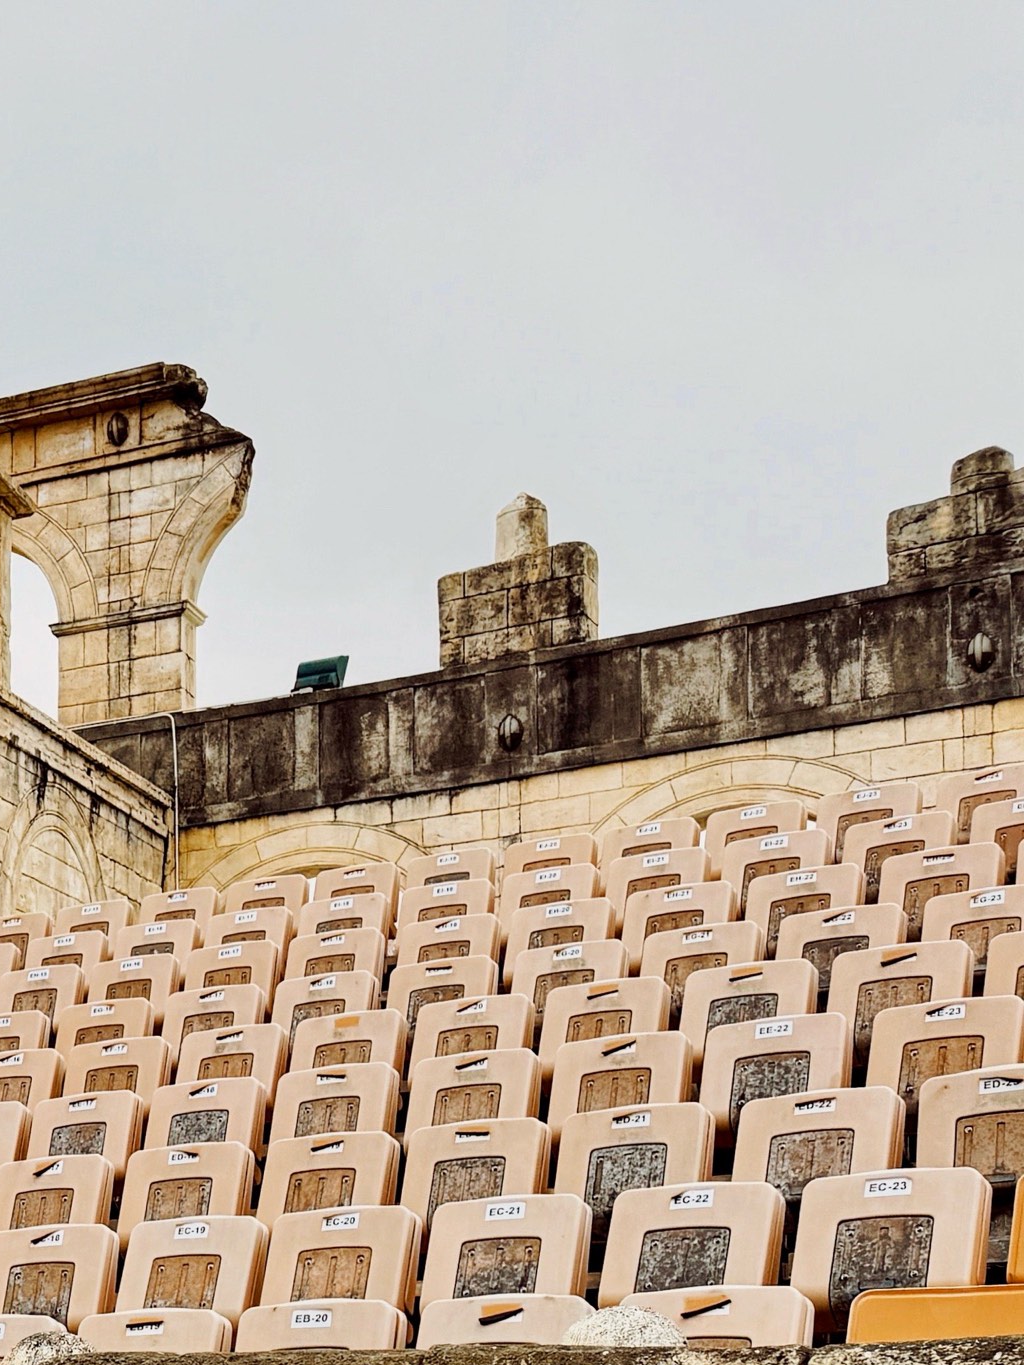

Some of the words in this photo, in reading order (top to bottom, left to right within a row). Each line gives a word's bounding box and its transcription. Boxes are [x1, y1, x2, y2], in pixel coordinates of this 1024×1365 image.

[855, 791, 878, 800] EJ-23
[764, 839, 784, 848] EI-22
[789, 873, 815, 882] EH-22
[972, 893, 1003, 903] EG-23
[759, 1024, 789, 1034] EE-22
[868, 1181, 908, 1192] EC-23
[673, 1194, 709, 1204] EC-22
[489, 1206, 521, 1215] EC-21
[325, 1216, 356, 1226] EC-20
[177, 1226, 206, 1234] EC-19
[295, 1314, 328, 1323] EB-20
